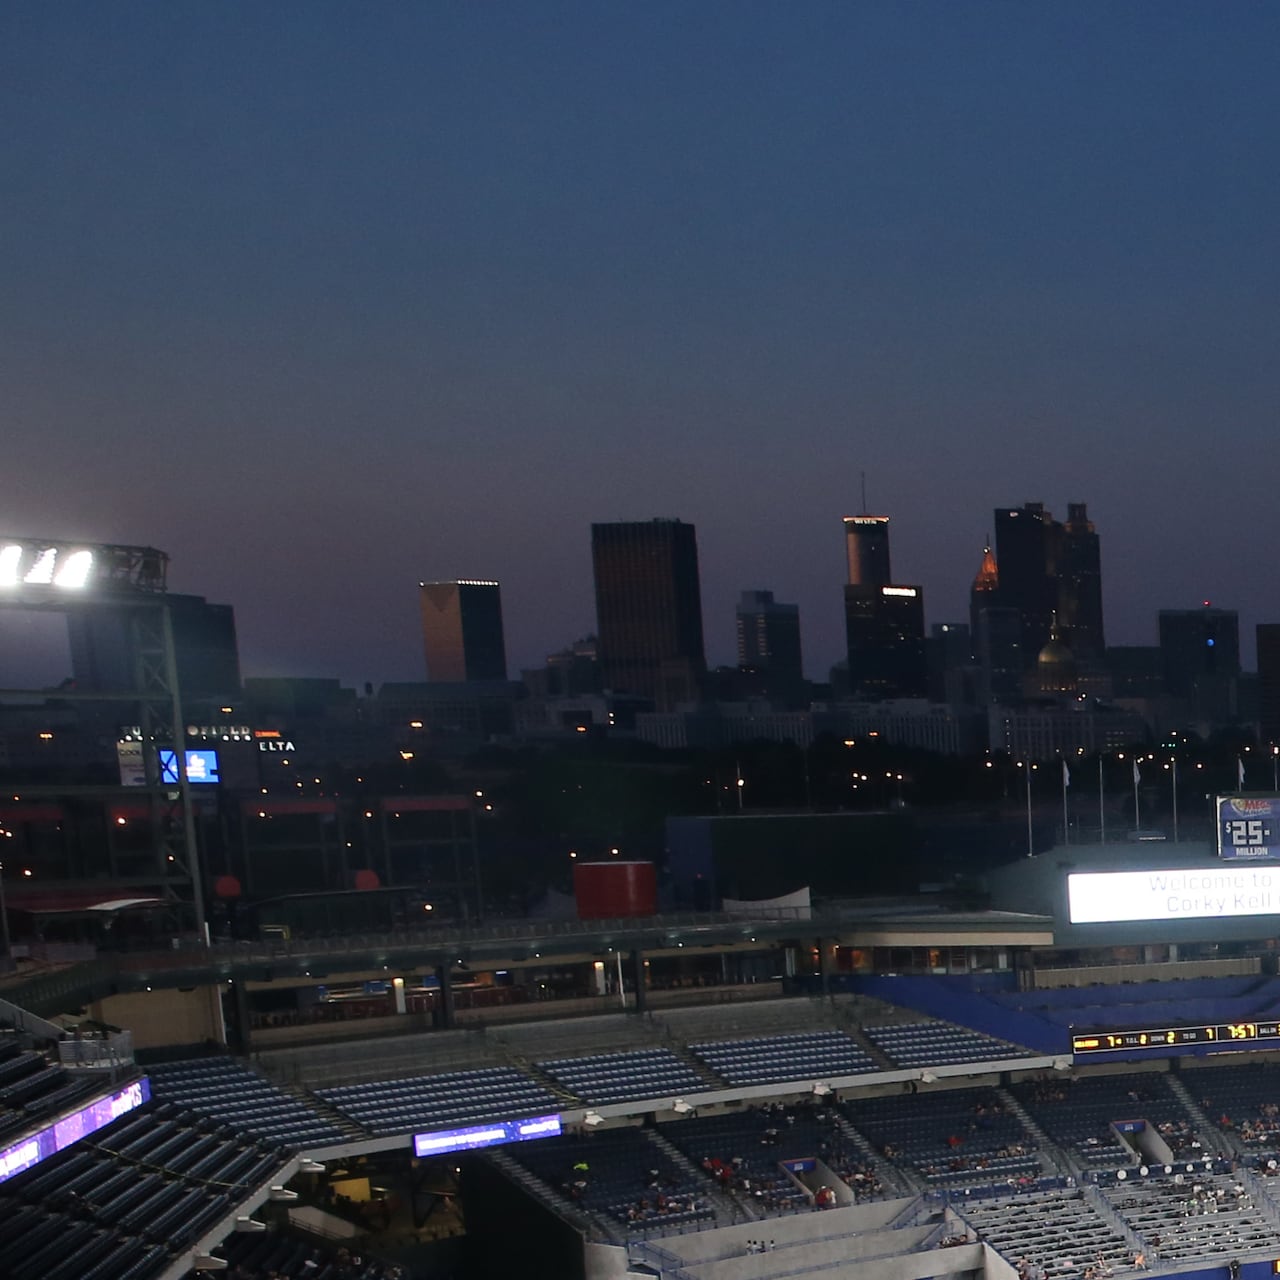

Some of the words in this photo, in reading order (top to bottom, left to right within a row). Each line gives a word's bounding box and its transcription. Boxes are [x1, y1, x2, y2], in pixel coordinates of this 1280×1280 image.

[1236, 847, 1268, 856] MILLION
[1149, 873, 1244, 891] Welcome
[1253, 873, 1272, 888] to
[1167, 896, 1226, 913] Corky
[1234, 891, 1270, 910] Kell
[1227, 1025, 1255, 1038] 7:57
